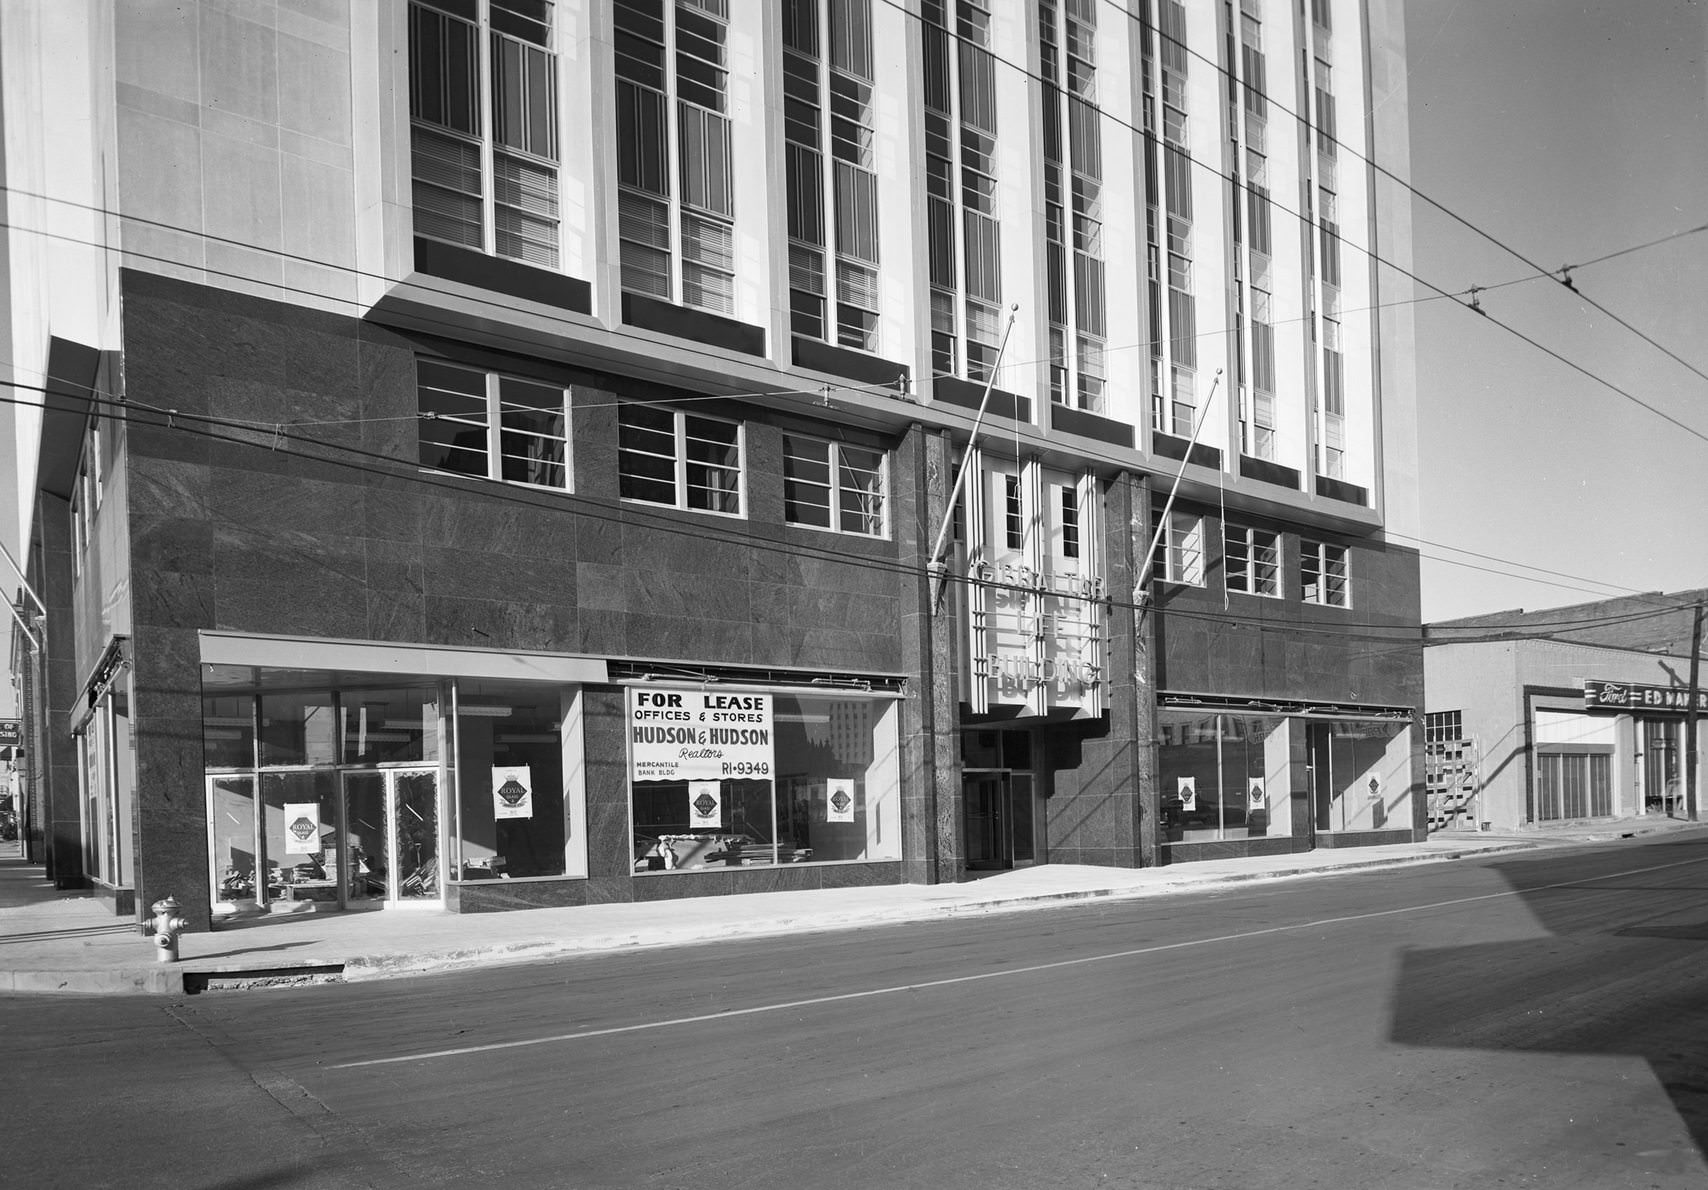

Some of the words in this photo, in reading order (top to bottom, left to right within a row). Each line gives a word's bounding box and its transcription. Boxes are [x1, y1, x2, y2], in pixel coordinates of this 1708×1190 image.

[1599, 682, 1628, 704] Ford
[1644, 689, 1663, 705] ED
[638, 692, 682, 708] FOR
[704, 695, 763, 711] LEASE
[634, 710, 691, 721] OFFICES
[699, 712, 706, 722] &
[712, 712, 764, 723] STORES
[633, 726, 696, 744] HUDSON
[698, 731, 706, 745] &
[710, 728, 769, 746] HUDSON
[678, 748, 724, 760] Realtors
[501, 786, 525, 794] ROYAL
[293, 823, 315, 832] ROYAL
